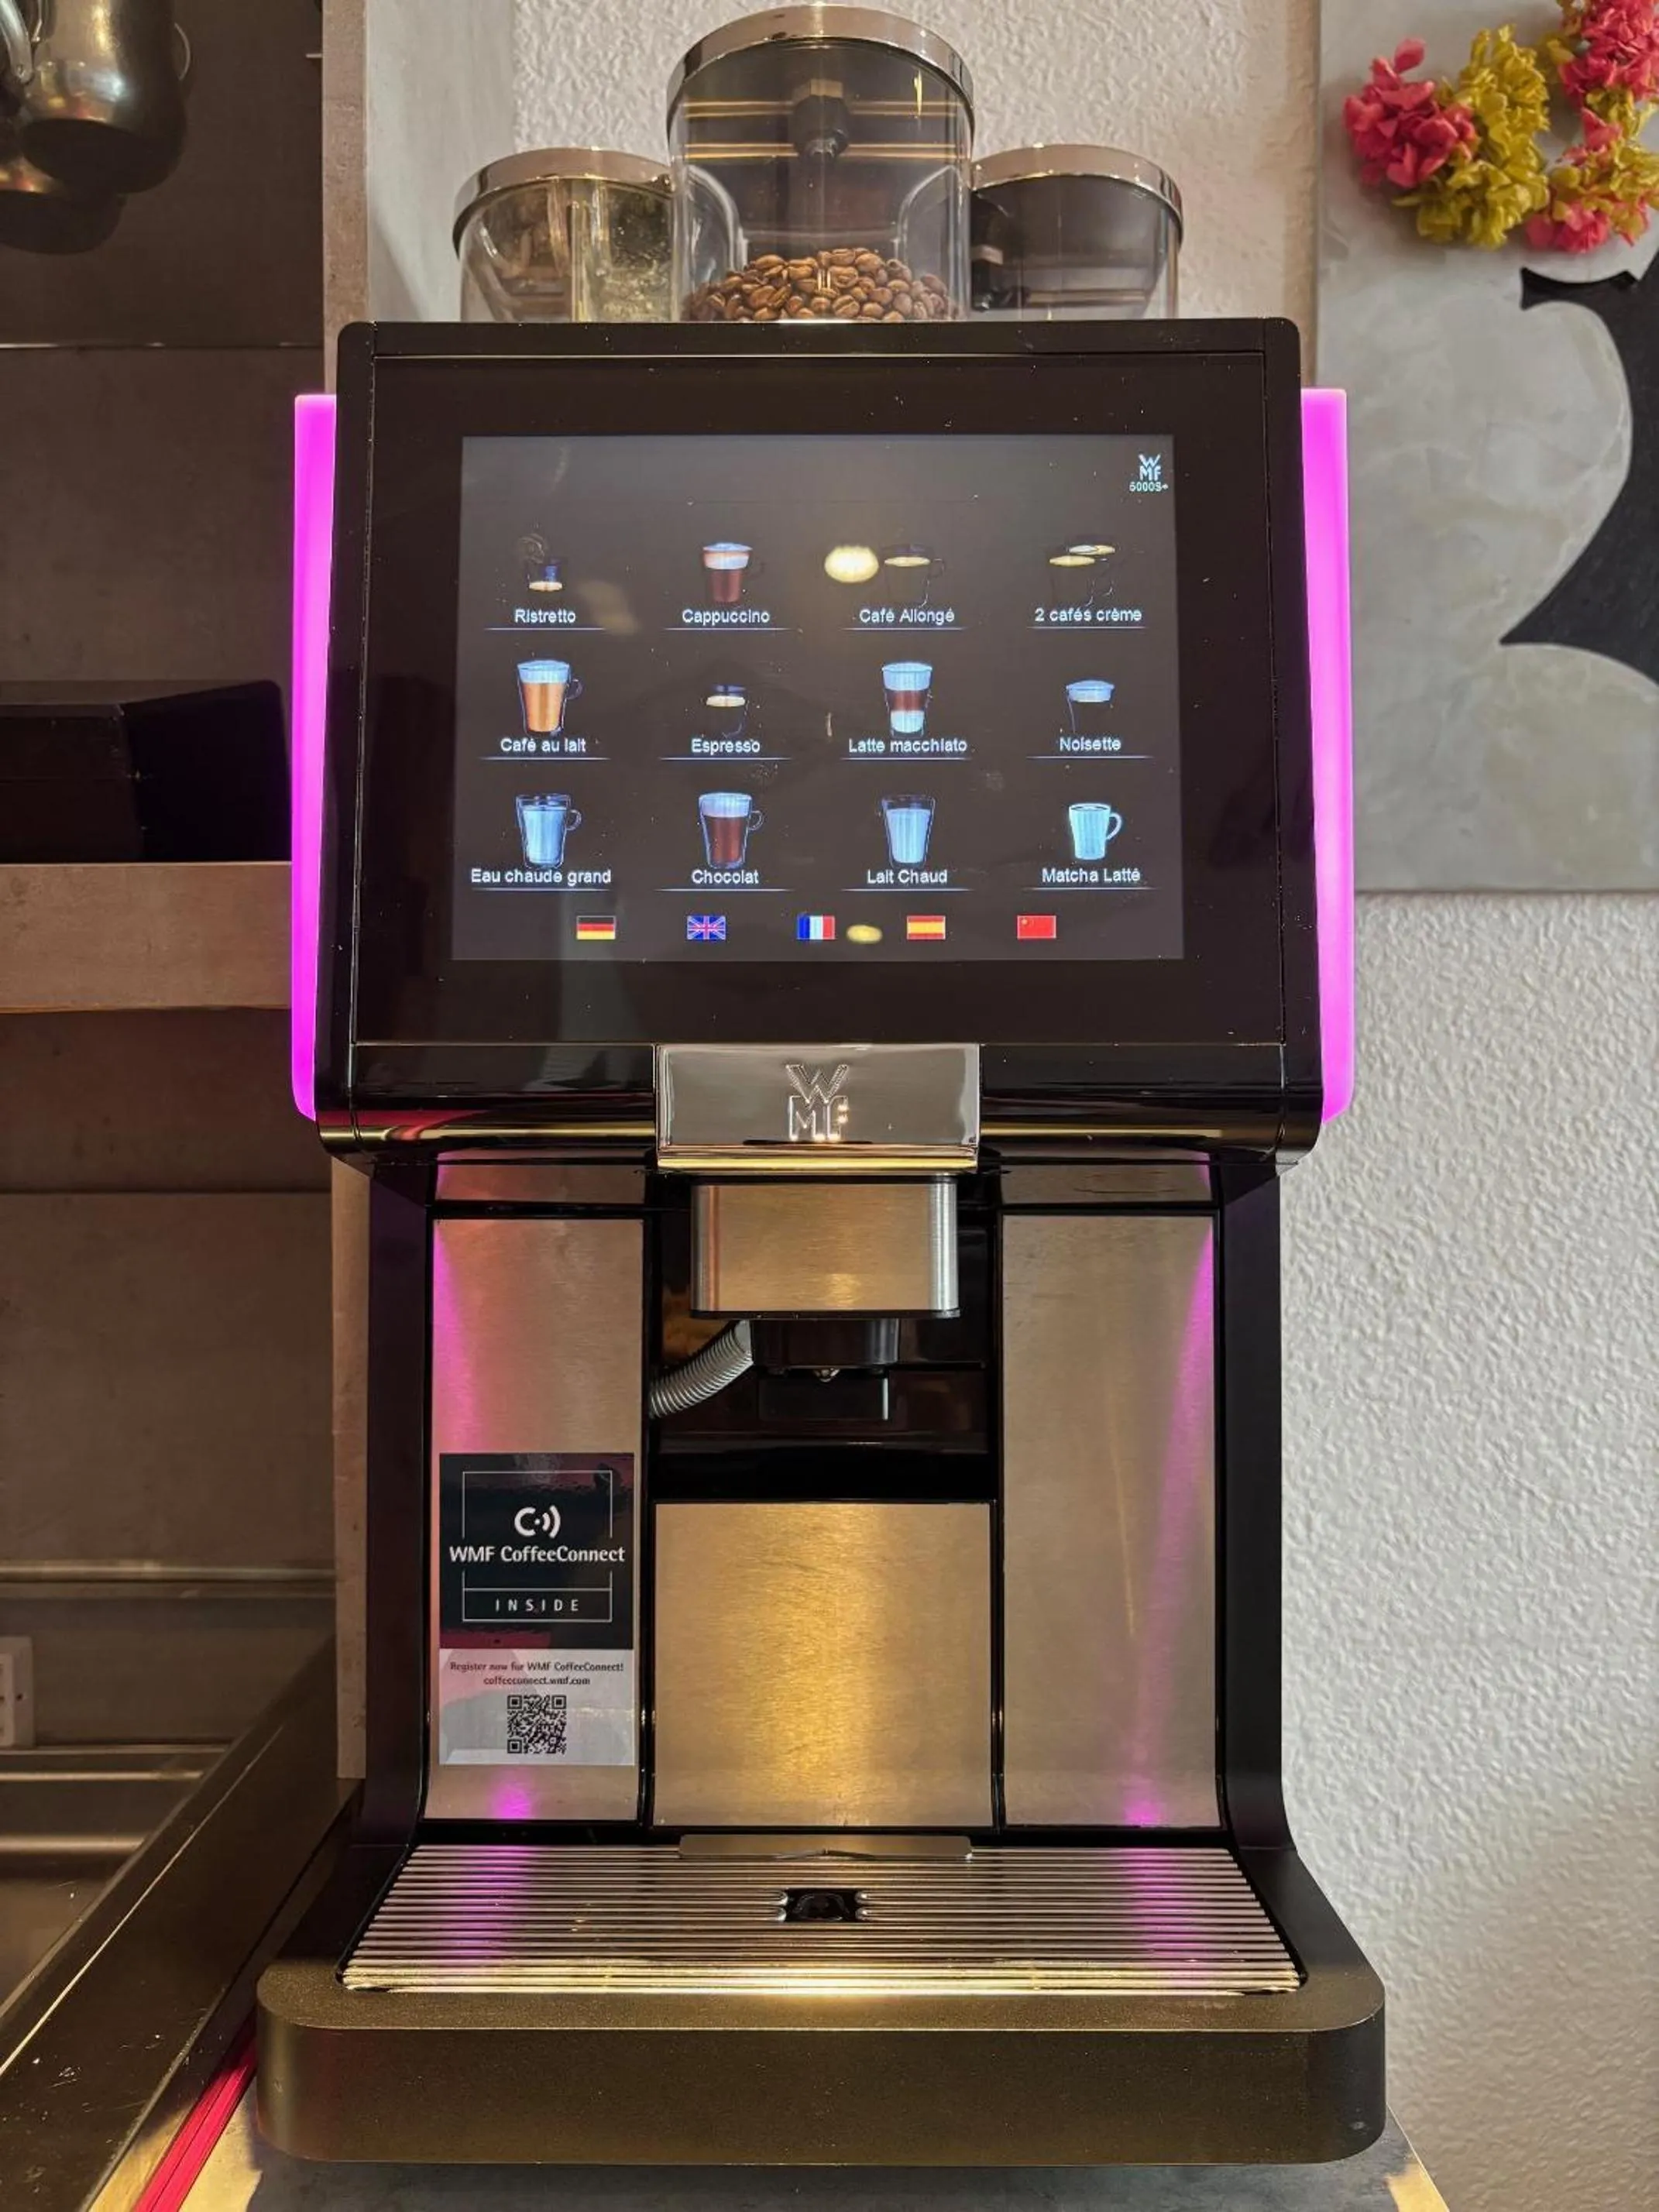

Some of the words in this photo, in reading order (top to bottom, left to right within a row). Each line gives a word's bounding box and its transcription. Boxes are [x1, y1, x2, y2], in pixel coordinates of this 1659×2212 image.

[514, 608, 576, 623] Ristretto
[682, 608, 770, 626] Cappuccino
[859, 608, 895, 623] Café
[901, 608, 955, 626] Allongé
[1035, 608, 1045, 622] 2
[1049, 608, 1092, 622] cafés
[1096, 608, 1142, 622] crème
[500, 737, 536, 753] Café
[541, 741, 560, 753] au
[564, 737, 586, 753] lait
[691, 738, 761, 756] Espresso
[849, 737, 886, 753] Latte
[890, 737, 967, 753] macchiato
[1060, 737, 1121, 751] Noisette
[471, 868, 500, 884] Eau
[505, 868, 563, 884] chaude
[568, 868, 612, 887] grand
[692, 868, 759, 884] Chocolat
[867, 868, 894, 884] Lait
[898, 868, 948, 884] Chaud
[1042, 867, 1099, 883] Matcha
[785, 1063, 850, 1142] WMF
[449, 1546, 496, 1562] WMF
[500, 1545, 626, 1563] CoffeeConnect
[495, 1599, 580, 1612] INSIDE
[450, 1661, 487, 1673] Register
[511, 1661, 524, 1671] for
[527, 1662, 552, 1671] WMF
[554, 1661, 623, 1672] CoffeeConnect!
[483, 1676, 591, 1686] coffeeconnect.wmf.com
